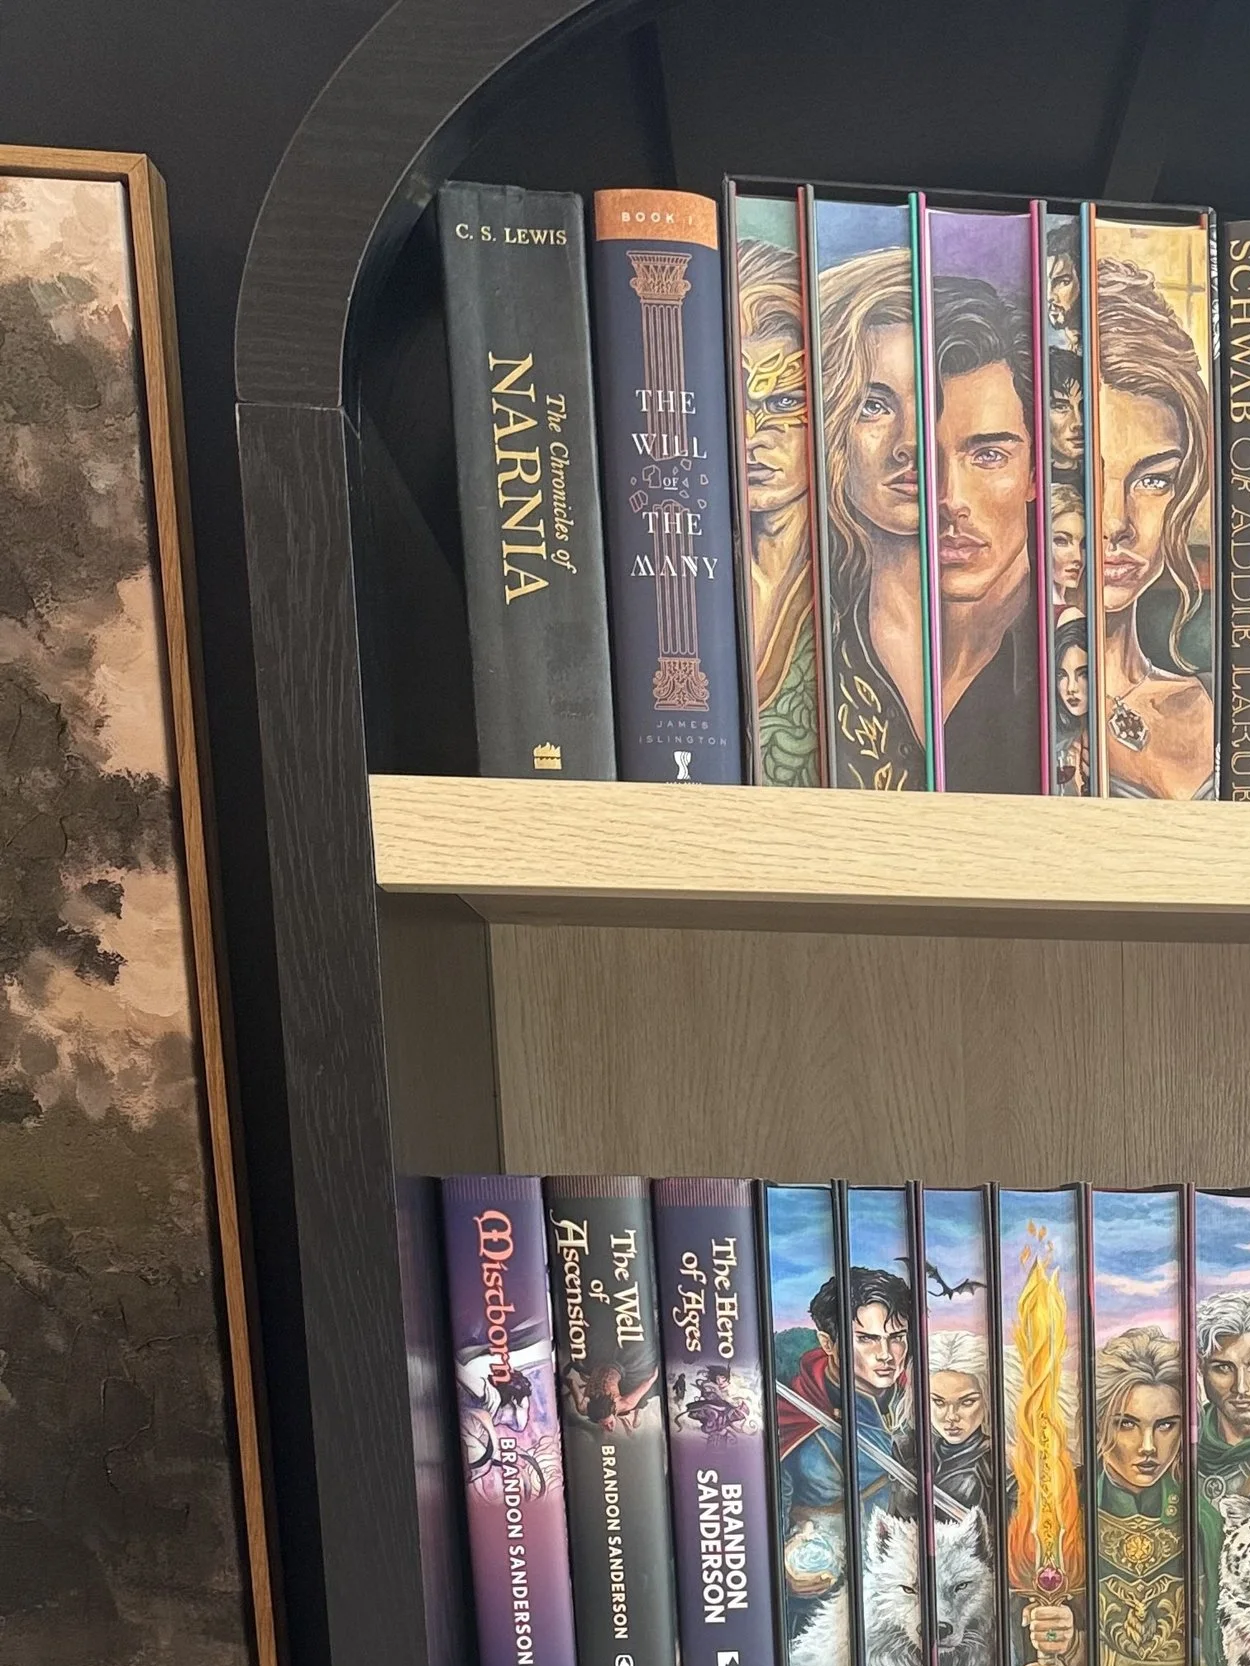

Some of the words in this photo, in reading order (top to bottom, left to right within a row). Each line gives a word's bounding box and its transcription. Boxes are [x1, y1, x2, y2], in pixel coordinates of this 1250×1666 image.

[455, 223, 474, 240] C.
[480, 226, 497, 242] S.
[504, 227, 567, 245] LEWIS
[621, 211, 675, 223] BOOK
[546, 393, 568, 433] The
[635, 389, 696, 415] THE
[632, 433, 707, 459] WILL
[487, 351, 550, 606] NARNIA
[549, 440, 575, 542] Chronicles
[663, 477, 678, 488] OF
[642, 511, 703, 535] THE
[551, 547, 578, 575] of
[630, 555, 718, 580] MANY
[639, 736, 728, 746] ISLINGTON
[656, 720, 709, 730] JAMES
[610, 1229, 638, 1282] The
[681, 1251, 707, 1285] of
[710, 1237, 738, 1289] The
[473, 1209, 516, 1386] Mistborn
[550, 1209, 591, 1361] Ascension
[587, 1278, 609, 1305] of
[613, 1282, 645, 1348] Well
[672, 1284, 706, 1353] Ages
[713, 1293, 739, 1359] Hero
[500, 1438, 524, 1538] BRANDON
[601, 1445, 621, 1531] BRANDON
[697, 1469, 725, 1623] SANDERSON
[721, 1483, 748, 1609] BRANDON
[509, 1545, 533, 1665] SANDERSON
[607, 1536, 628, 1639] SANDERSON
